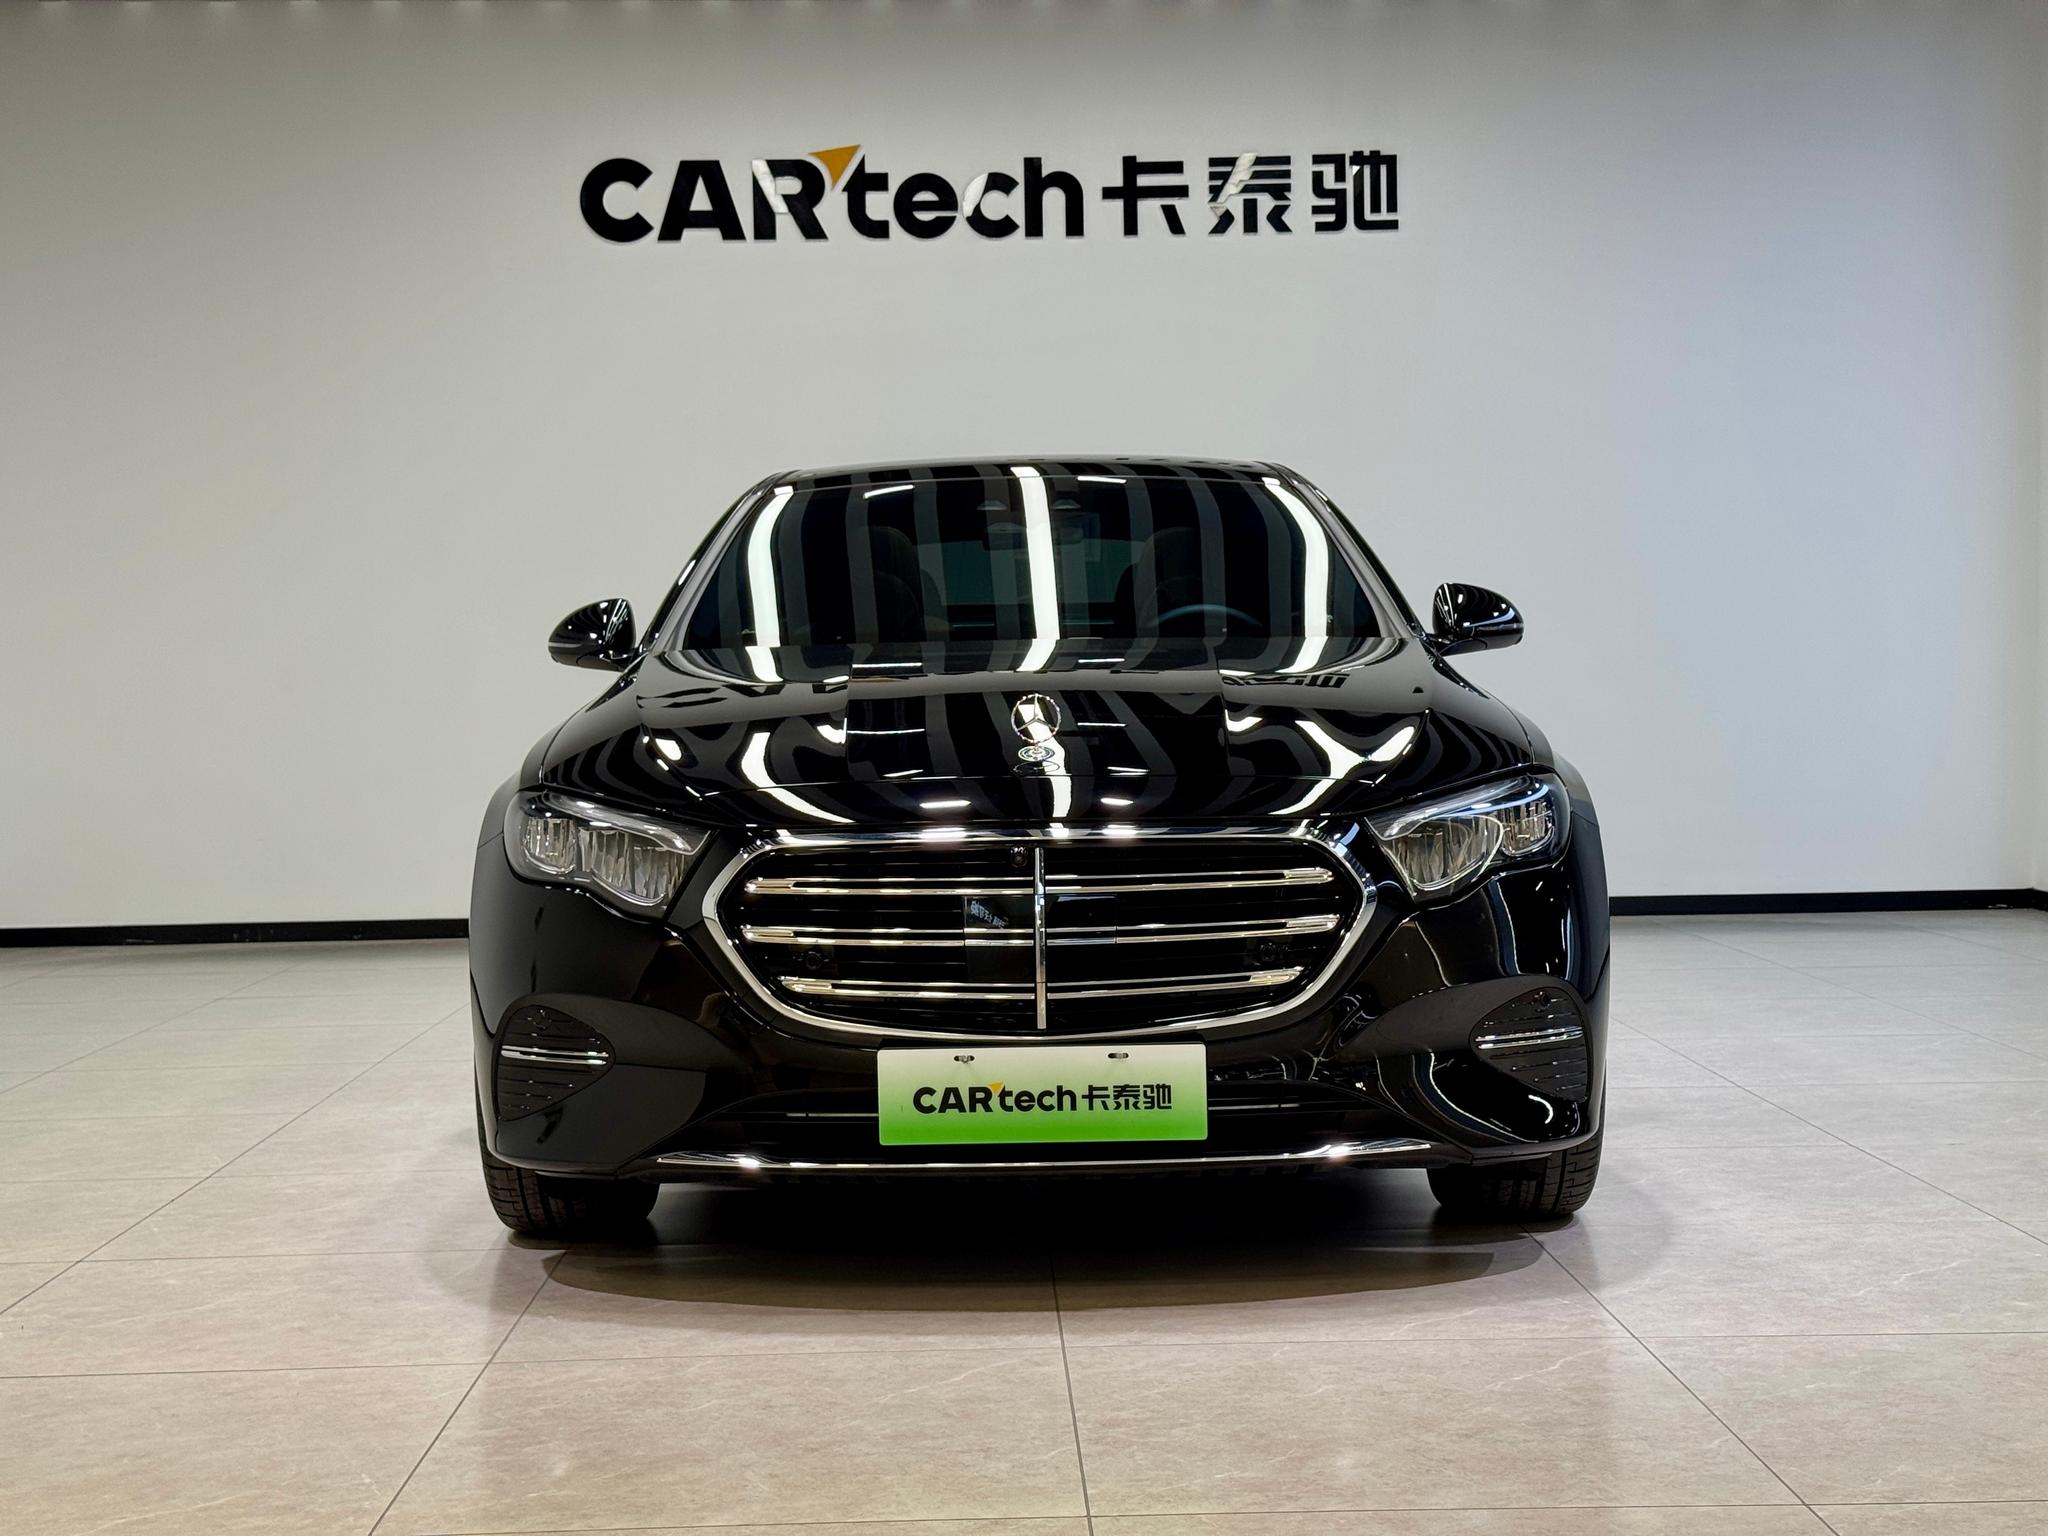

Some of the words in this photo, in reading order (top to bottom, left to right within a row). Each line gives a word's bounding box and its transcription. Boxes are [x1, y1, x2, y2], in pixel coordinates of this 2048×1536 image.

[579, 146, 1085, 243] CARtech
[1101, 149, 1400, 237] 卡泰驰
[912, 1082, 1077, 1114] CARtech
[1081, 1084, 1173, 1111] 卡泰驰
